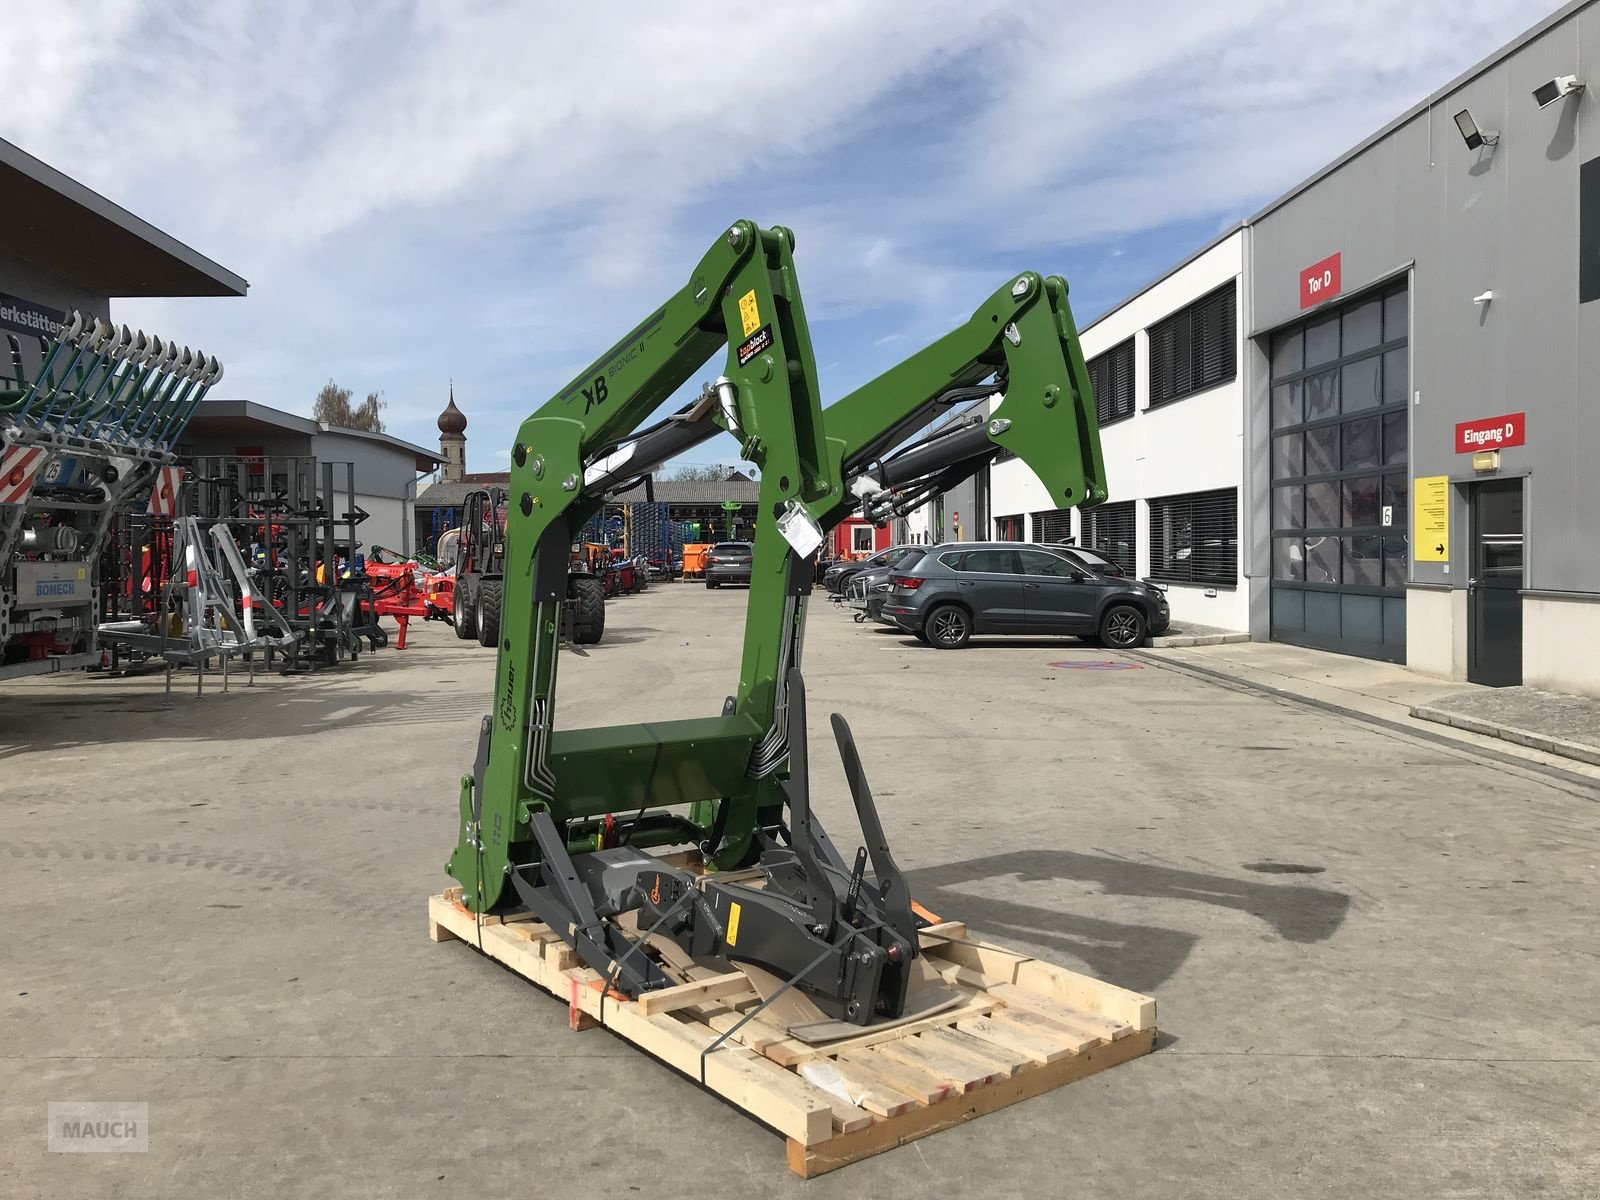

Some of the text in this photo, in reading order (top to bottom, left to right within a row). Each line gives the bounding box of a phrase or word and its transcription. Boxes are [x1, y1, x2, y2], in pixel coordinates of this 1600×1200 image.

[1308, 270, 1332, 295] Tor D
[0, 305, 62, 334] erkstätte
[608, 347, 638, 378] BIONIC
[1464, 423, 1514, 445] Eingang D
[46, 463, 60, 479] 25
[1384, 508, 1391, 524] 6
[36, 583, 75, 597] BOMECH
[504, 659, 515, 721] hauer
